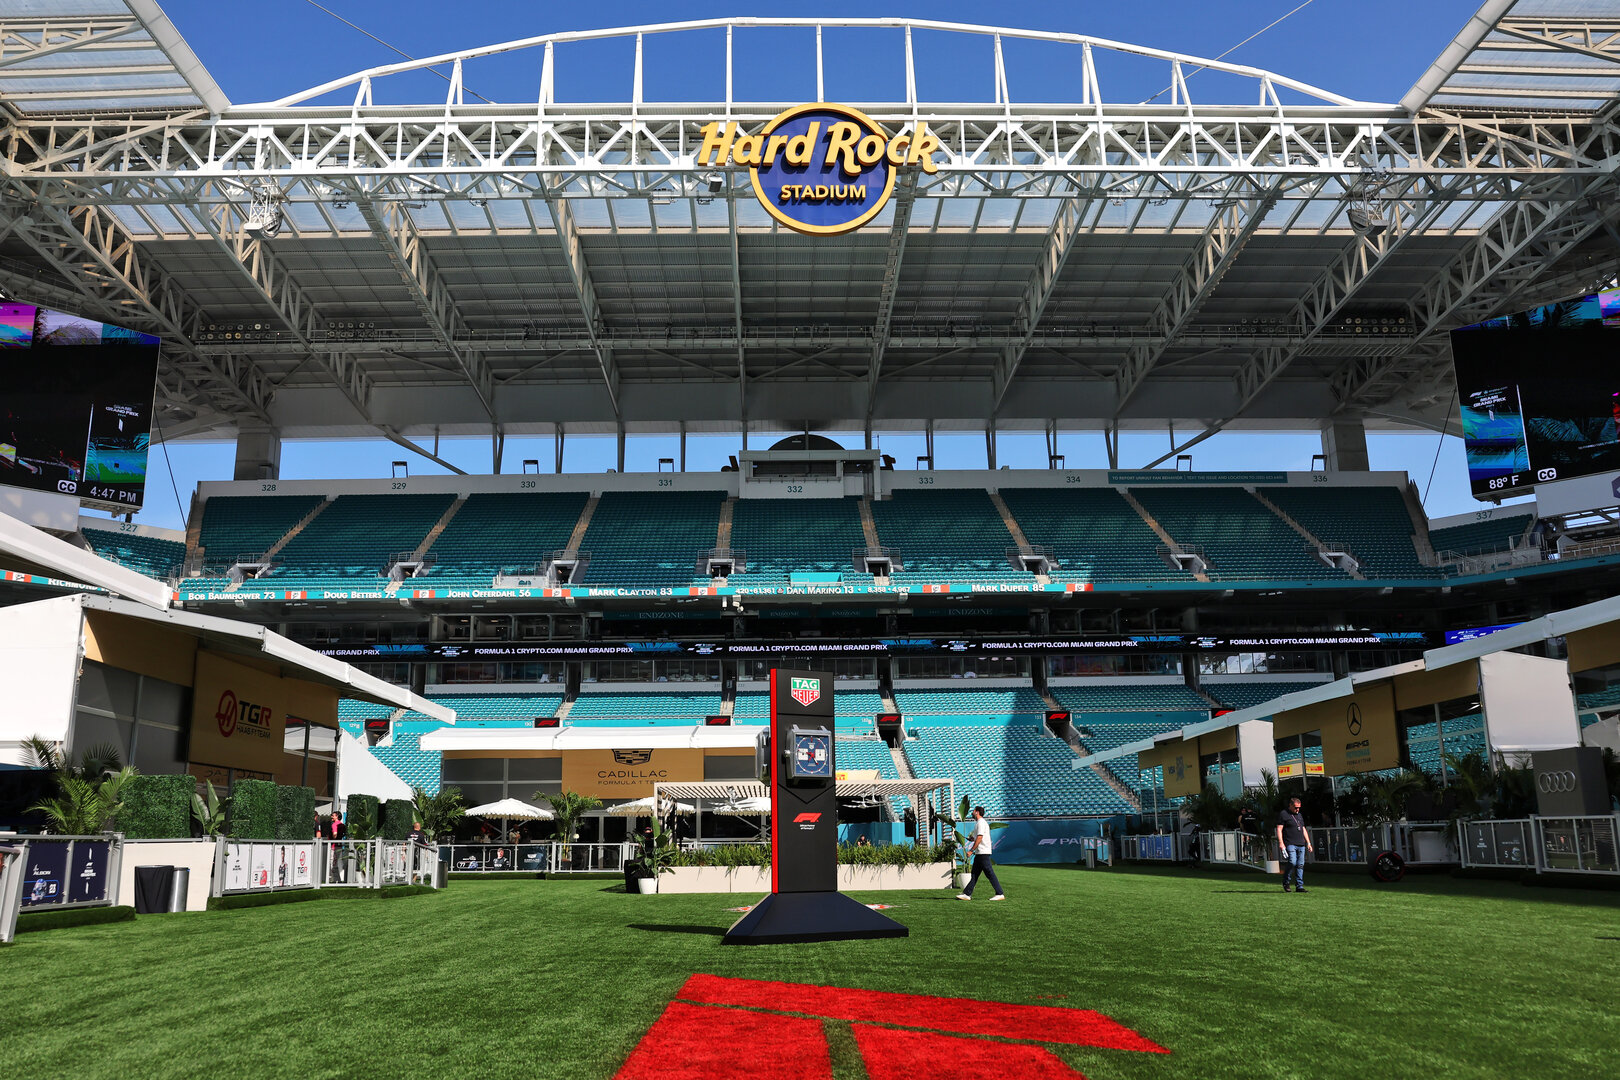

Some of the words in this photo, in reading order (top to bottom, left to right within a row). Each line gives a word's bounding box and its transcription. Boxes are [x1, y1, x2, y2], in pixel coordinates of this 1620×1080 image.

[698, 121, 820, 167] Hard
[825, 121, 938, 176] Rock
[780, 185, 866, 201] STADIUM
[1066, 475, 1081, 483] 334
[1313, 475, 1328, 483] 336
[1538, 469, 1555, 480] CC
[520, 480, 536, 488] 330
[658, 479, 673, 487] 331
[919, 477, 934, 485] 333
[1511, 475, 1519, 486] F
[59, 481, 76, 493] CC
[261, 484, 276, 492] 328
[391, 482, 407, 490] 329
[787, 485, 803, 493] 332
[90, 486, 115, 499] 4:47
[119, 491, 137, 503] PM
[1475, 511, 1493, 521] 337
[119, 522, 138, 533] 327
[589, 588, 615, 596] MARK
[617, 587, 657, 596] CLAYTON
[660, 587, 673, 596] 83
[787, 587, 805, 595] DAN
[807, 586, 842, 595] MARINO
[844, 586, 854, 594] 13
[971, 583, 998, 592] MARK
[1000, 583, 1029, 592] DUPER
[1032, 583, 1045, 592] 85
[188, 592, 205, 600] BOB
[208, 591, 261, 600] BAUMHOWER
[264, 591, 276, 599] 73
[324, 591, 349, 599] DOUG
[351, 590, 382, 599] BETTERS
[385, 590, 396, 599] 75
[447, 590, 470, 598] JOHN
[472, 589, 516, 598] OFFERDAHL
[519, 589, 531, 597] 56
[948, 608, 992, 616] ENDZONE
[793, 679, 817, 690] TAG
[792, 689, 819, 705] HEUER
[238, 700, 272, 728] TGR
[257, 730, 271, 739] TEAM
[597, 770, 668, 778] CADILLAC
[1504, 851, 1508, 859] 5
